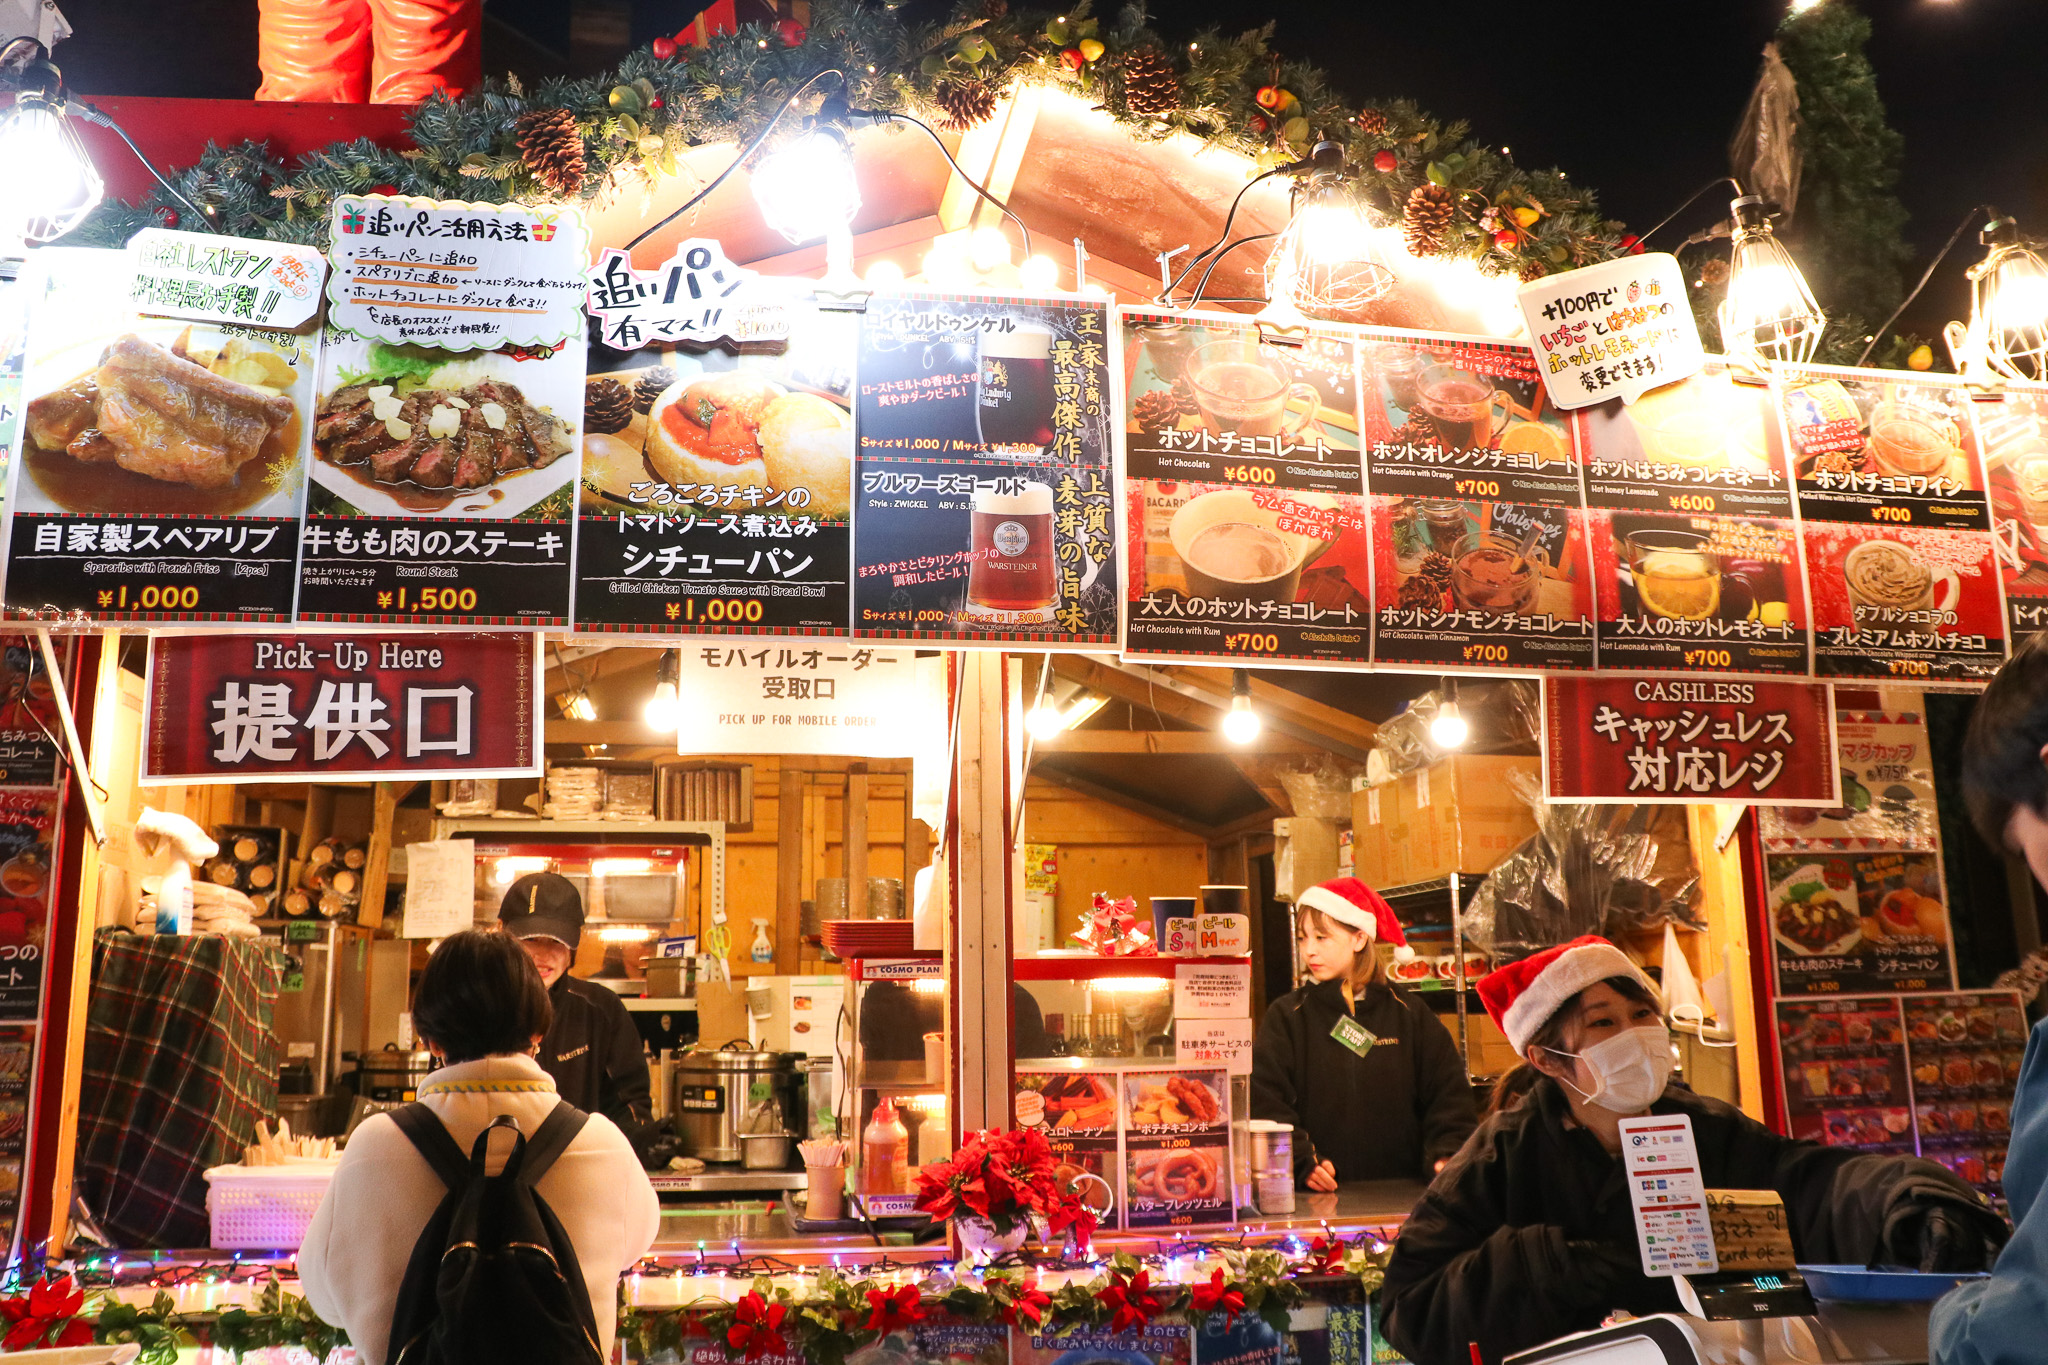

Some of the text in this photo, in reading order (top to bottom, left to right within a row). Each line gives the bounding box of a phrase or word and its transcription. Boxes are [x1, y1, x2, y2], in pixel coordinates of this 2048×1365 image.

[367, 208, 528, 242] 追いパン活用方法
[358, 247, 478, 265] シチューパンに追加
[356, 265, 458, 285] スペアリブに追加
[592, 248, 742, 309] 追いパン
[1542, 287, 1618, 320] +100円で
[862, 371, 980, 395] ローストモルトの香ばしさの
[1050, 340, 1085, 463] 最高傑作
[861, 437, 1036, 454] Sサイズ ¥1,000 Mサイズ ¥1,300
[1159, 426, 1332, 461] ホットチョコレート
[1159, 458, 1210, 469] Hot Chocolate
[1373, 441, 1578, 473] ホットオレンジチョコレート
[1224, 466, 1276, 484] ¥600
[1386, 468, 1416, 476] Chocolate
[1432, 470, 1454, 479] Orange
[1591, 457, 1781, 487] ホットはちみつレモネード
[864, 472, 1026, 496] ブルワーズゴールド
[1455, 480, 1500, 497] ¥700
[1592, 485, 1659, 497] Hot honey Lemonade
[1816, 469, 1963, 497] ホットチョコワイン
[628, 481, 811, 508] ごろごろチキンの
[869, 500, 888, 508] Style
[894, 500, 928, 509] ZWICKEL
[1669, 495, 1716, 511] ¥600
[1081, 473, 1111, 562] 上質な
[1253, 494, 1364, 530] ラム酒でからだは
[1872, 506, 1912, 522] ¥700
[618, 511, 819, 538] トマトソース煮込み
[35, 522, 279, 554] 自家製スペアリブ
[303, 525, 564, 558] 牛もも肉のステーキ
[623, 544, 814, 578] シチューパン
[1056, 475, 1088, 633] 麦芽の旨味
[83, 562, 133, 574] Spareribs
[134, 563, 156, 574] with
[157, 563, 191, 574] French
[194, 564, 220, 575] Frise
[396, 566, 427, 577] Round
[429, 567, 458, 578] Steak
[988, 561, 1037, 570] WARSTEINER
[303, 577, 375, 586] お時間いただきます
[609, 582, 825, 597] Grilled Chicken Tomato Sauce with Bread Bowl
[98, 585, 199, 611] ¥1,000
[377, 587, 477, 612] ¥1,500
[1140, 592, 1359, 624] 大人のホットチョコレート
[666, 598, 763, 623] ¥1,000
[863, 609, 1043, 624] Sサイズ ¥1,000 Mサイズ ¥1,300
[1381, 606, 1593, 635] ホットシナモンチョコレート
[1855, 605, 1958, 626] ダブルショコラの
[1131, 624, 1220, 636] Hot Chocolate with Rum
[1380, 630, 1391, 638] Hot
[1393, 631, 1423, 640] Chocolate
[1439, 633, 1469, 642] Cinnamon
[1616, 614, 1795, 640] 大人のホットレモネード
[1225, 633, 1278, 652] ¥700
[1600, 642, 1613, 650] Hot
[1614, 643, 1649, 651] Lemonade
[1665, 644, 1681, 652] Rum
[1829, 627, 1986, 650] プレミアムホットチョコ
[256, 642, 442, 671] Pick-Up Here
[701, 648, 897, 671] モバイルオーダー
[1463, 645, 1508, 661] ¥700
[1684, 650, 1731, 667] ¥700
[762, 676, 835, 699] 受取口
[1634, 682, 1755, 704] CASHLESS
[211, 680, 474, 763] 提供口
[719, 714, 877, 727] PICK UP FOR MOBILE ORDER
[1594, 705, 1794, 744] キャッシュレス
[1628, 747, 1783, 792] 対応レジ
[1203, 916, 1236, 929] ビール
[880, 965, 941, 974] COSMO PLAN
[1878, 959, 1939, 973] シチューパン
[1182, 1041, 1252, 1049] 駐車券サービスの
[1195, 1050, 1239, 1060] 対象外です
[1141, 1122, 1209, 1135] ポテチキコンボ
[1052, 1143, 1074, 1151] ¥600
[1161, 1139, 1191, 1149] ¥1,000
[1171, 1216, 1193, 1225] ¥600
[1753, 1276, 1783, 1290] 1600
